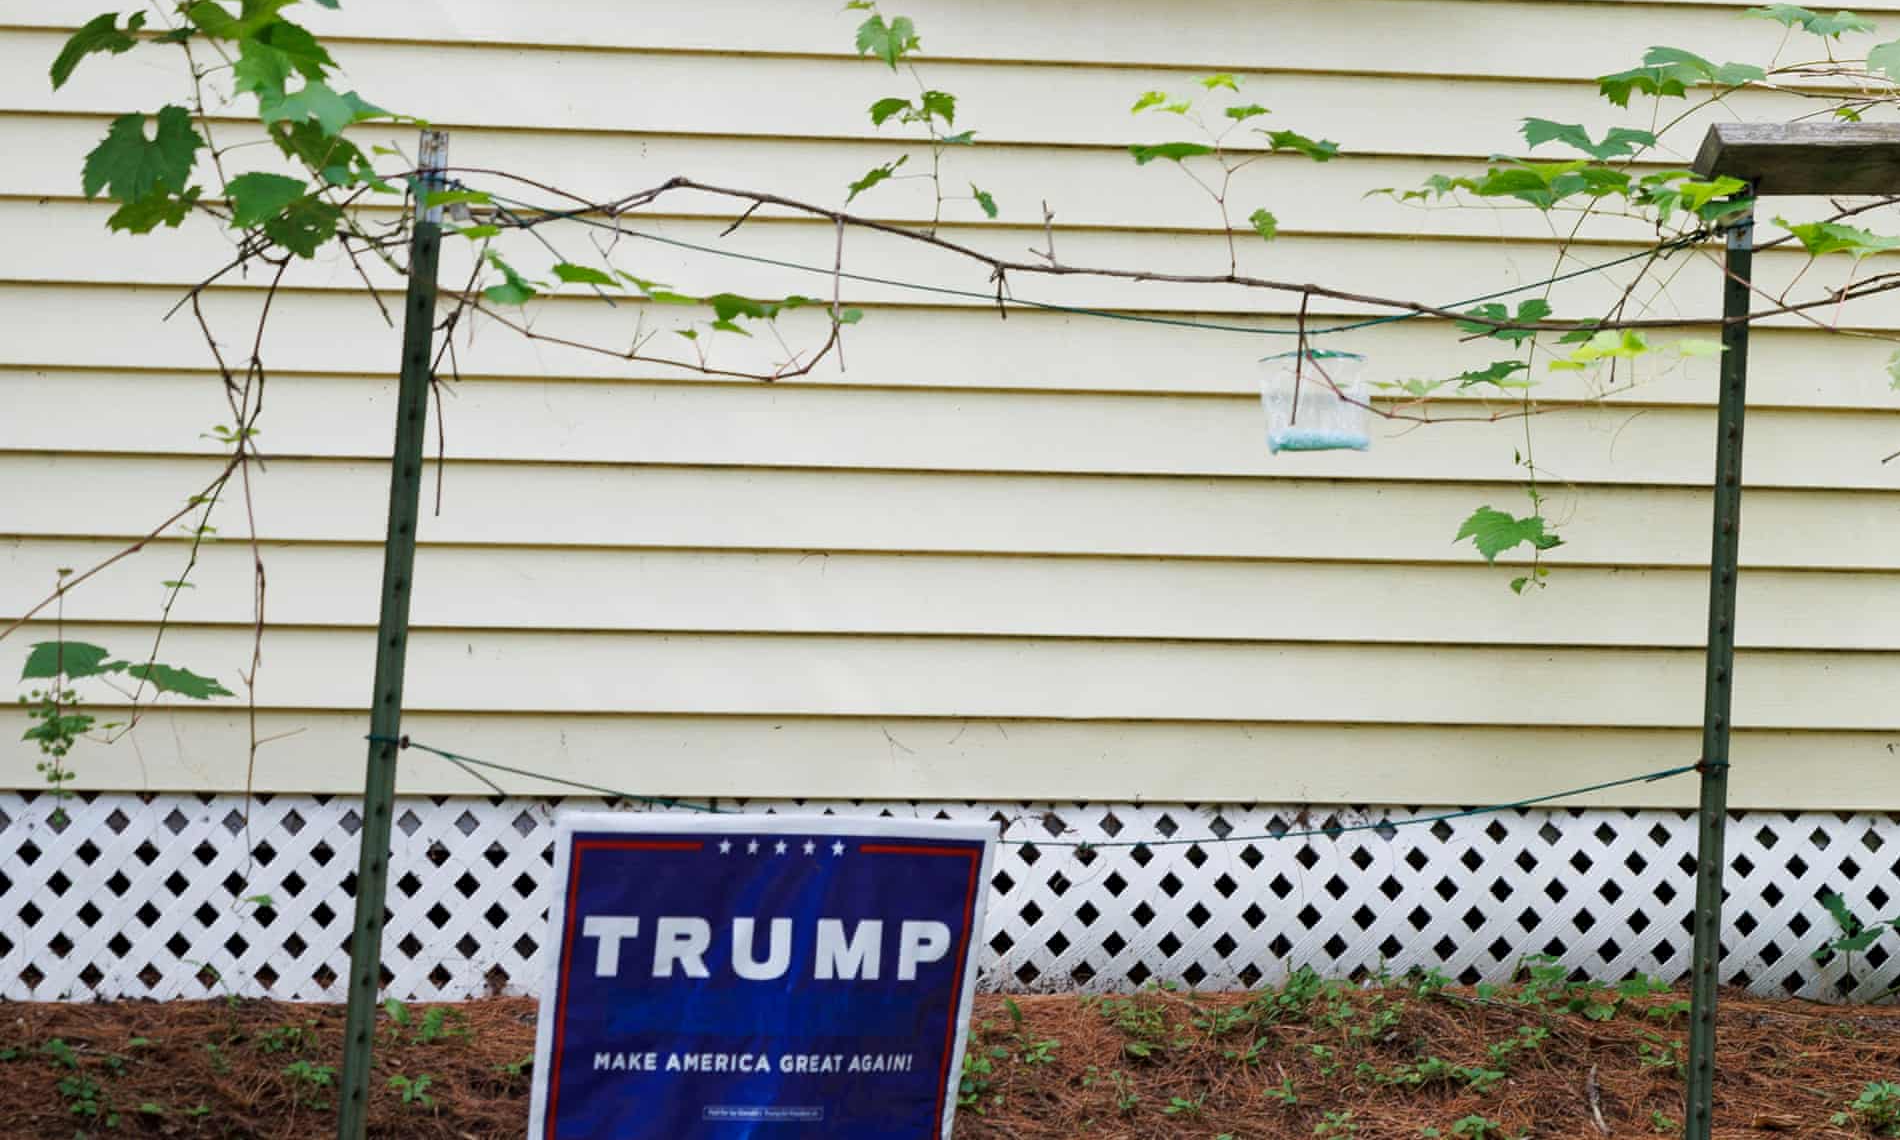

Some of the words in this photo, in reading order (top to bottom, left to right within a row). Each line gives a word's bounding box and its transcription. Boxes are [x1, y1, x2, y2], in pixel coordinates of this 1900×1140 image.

[581, 915, 952, 981] TRUMP
[593, 1051, 658, 1072] MAKE
[665, 1052, 772, 1074] AMERICA
[779, 1054, 844, 1074] GREAT
[847, 1053, 913, 1073] AGAIN!
